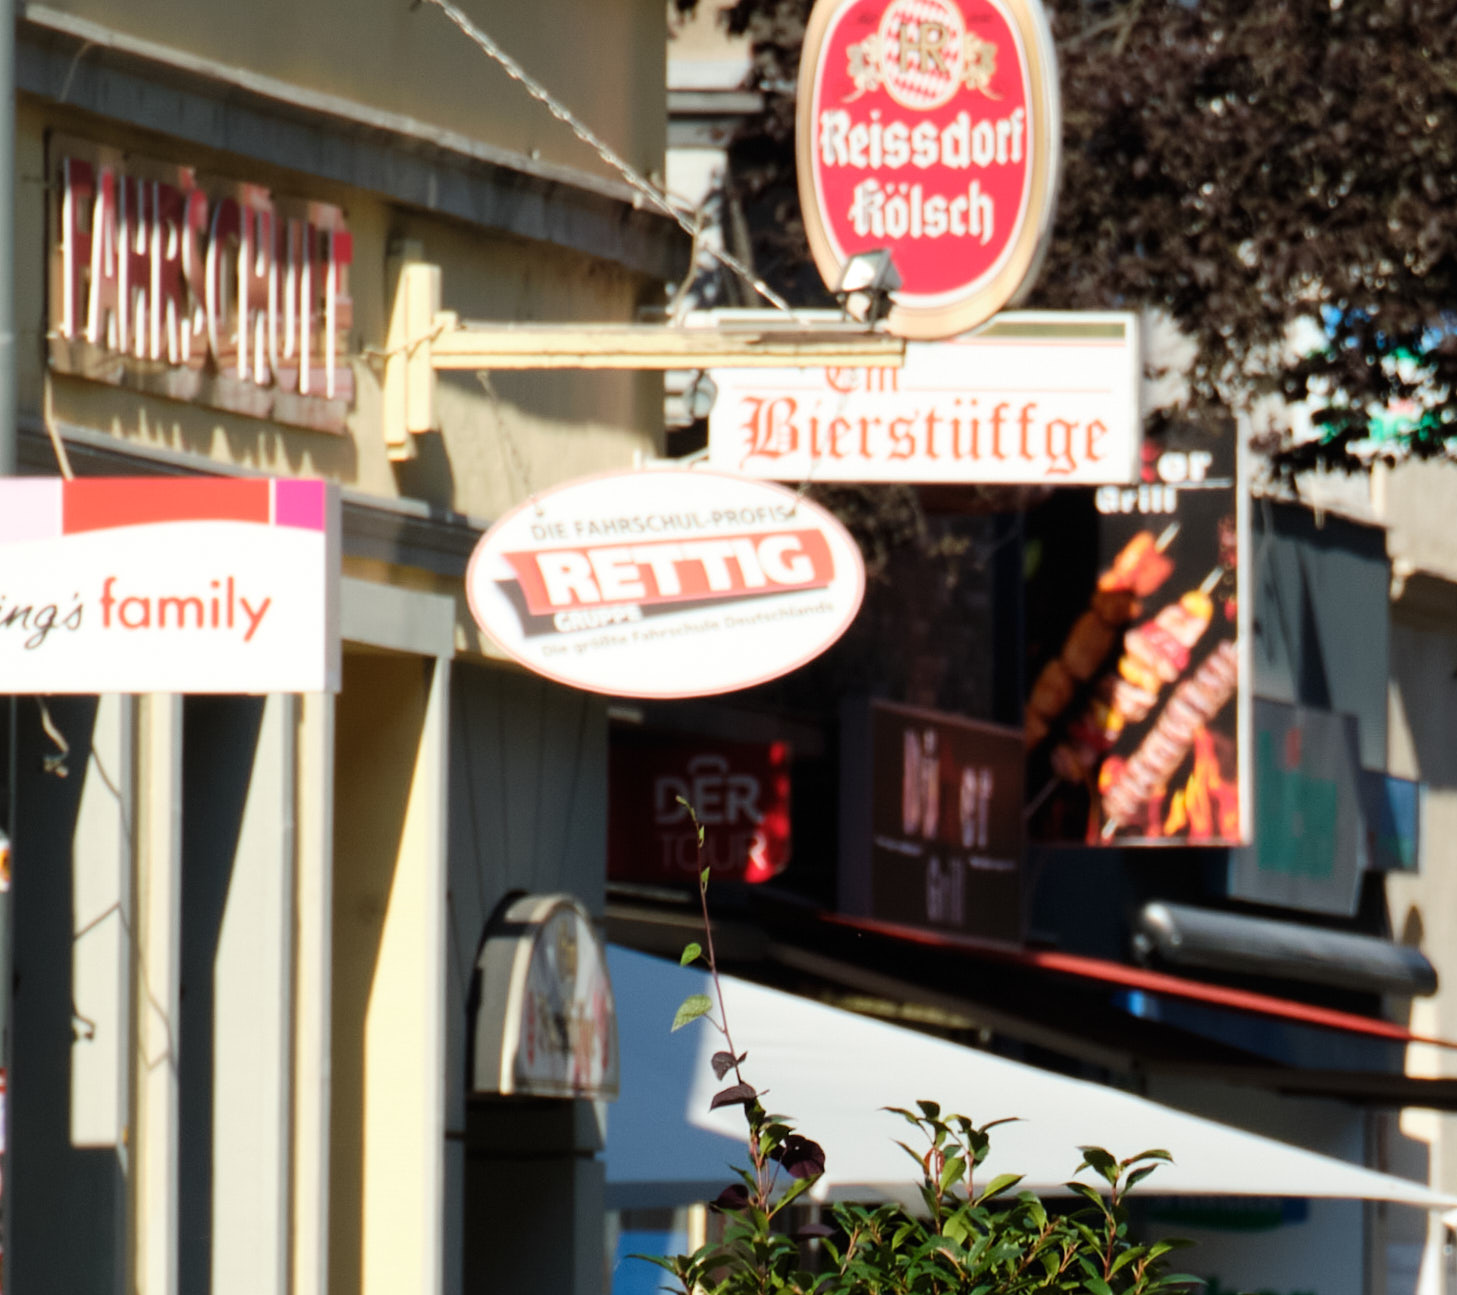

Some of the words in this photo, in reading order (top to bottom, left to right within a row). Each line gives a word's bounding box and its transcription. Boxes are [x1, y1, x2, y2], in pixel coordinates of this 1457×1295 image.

[820, 106, 1025, 170] Reissdorf
[847, 177, 996, 246] Kölsch
[61, 157, 355, 398] FAHRSCHULE
[531, 522, 568, 541] DIE
[575, 504, 793, 537] FAHRSCHUL-PROFIS
[1094, 484, 1177, 514] Grill
[536, 534, 815, 607] RETTIG
[100, 576, 272, 643] family
[632, 619, 720, 641] Fahrschule
[654, 774, 764, 824] DER
[660, 831, 768, 871] TOUR
